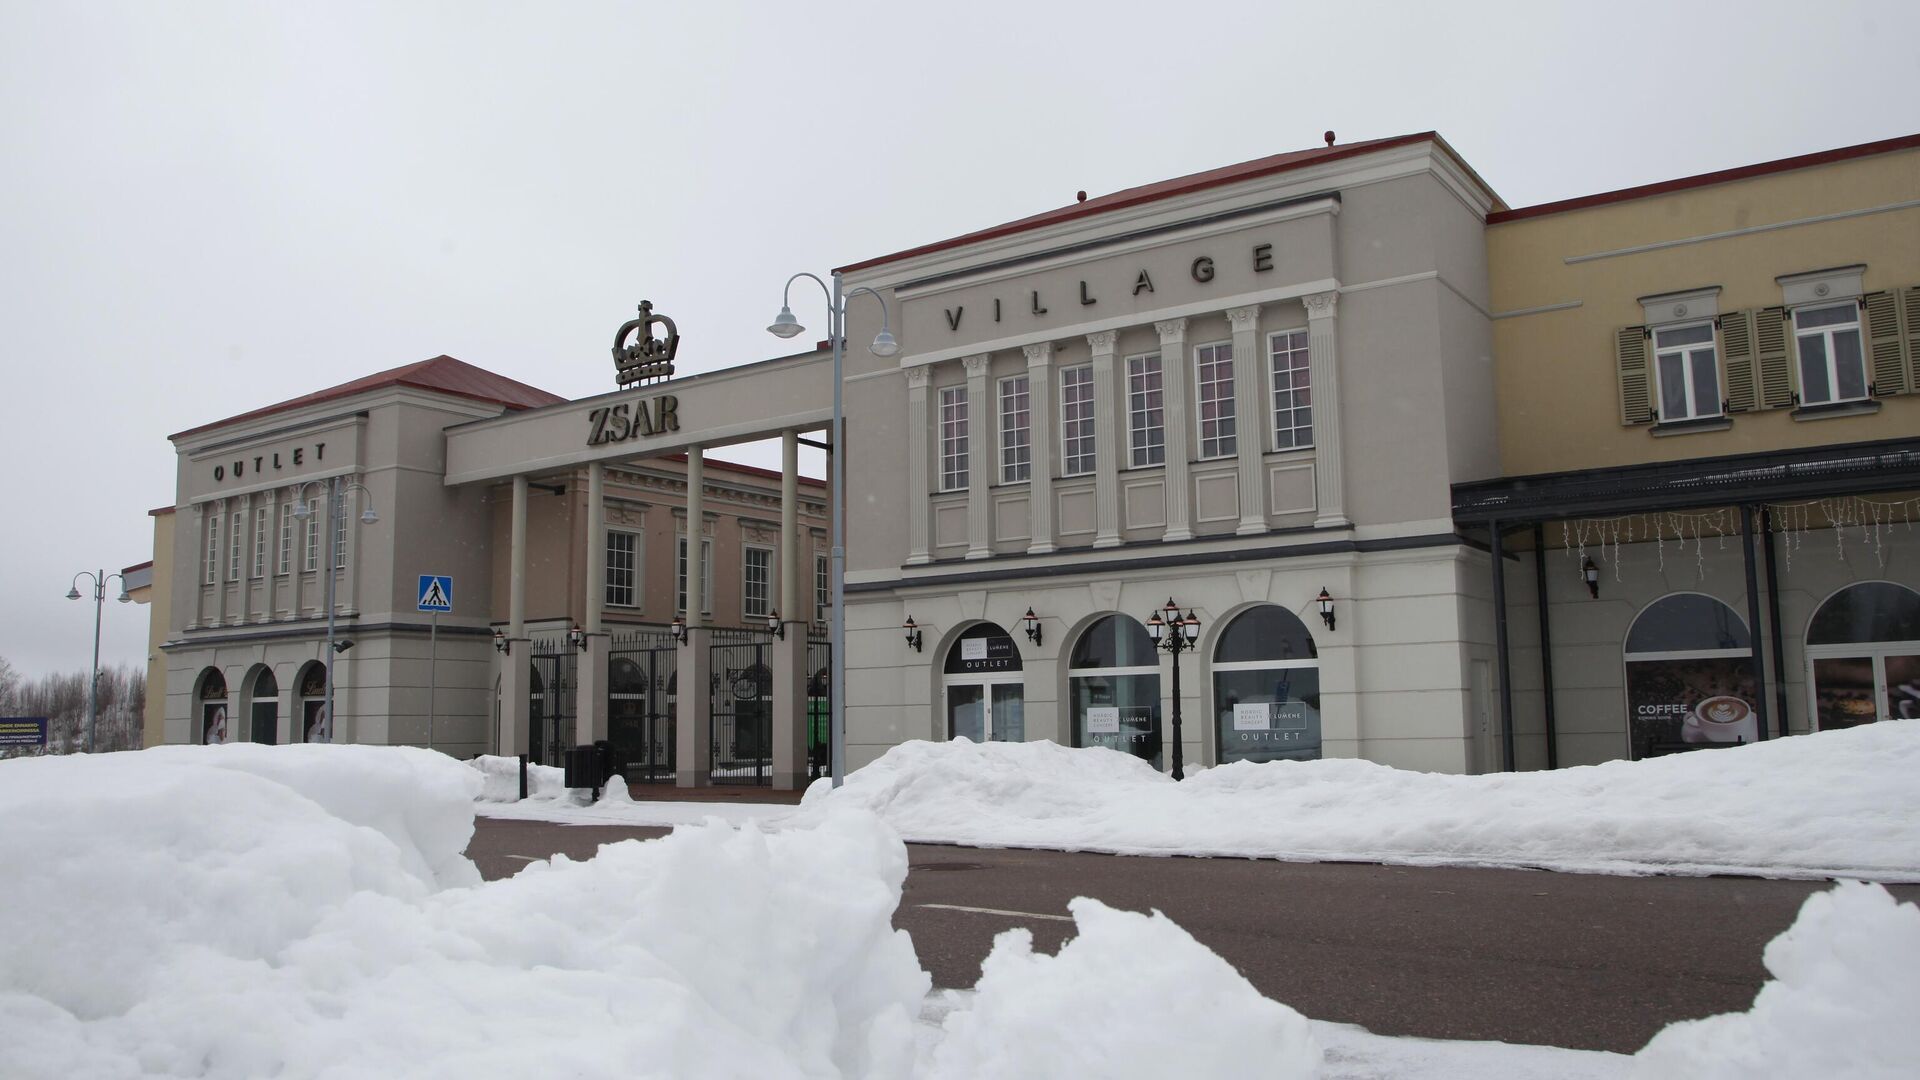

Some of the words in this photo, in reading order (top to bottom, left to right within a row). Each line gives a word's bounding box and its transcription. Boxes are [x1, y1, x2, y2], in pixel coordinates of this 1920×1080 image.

[944, 243, 1274, 331] VILLAGE
[586, 394, 681, 446] ZSAR
[213, 442, 326, 481] OUTLET
[966, 660, 1009, 668] OUTLET
[1638, 704, 1688, 715] COFFEE
[1273, 711, 1301, 719] LUMENE
[1093, 735, 1146, 743] OUTLET
[1241, 732, 1300, 741] OUTLET
